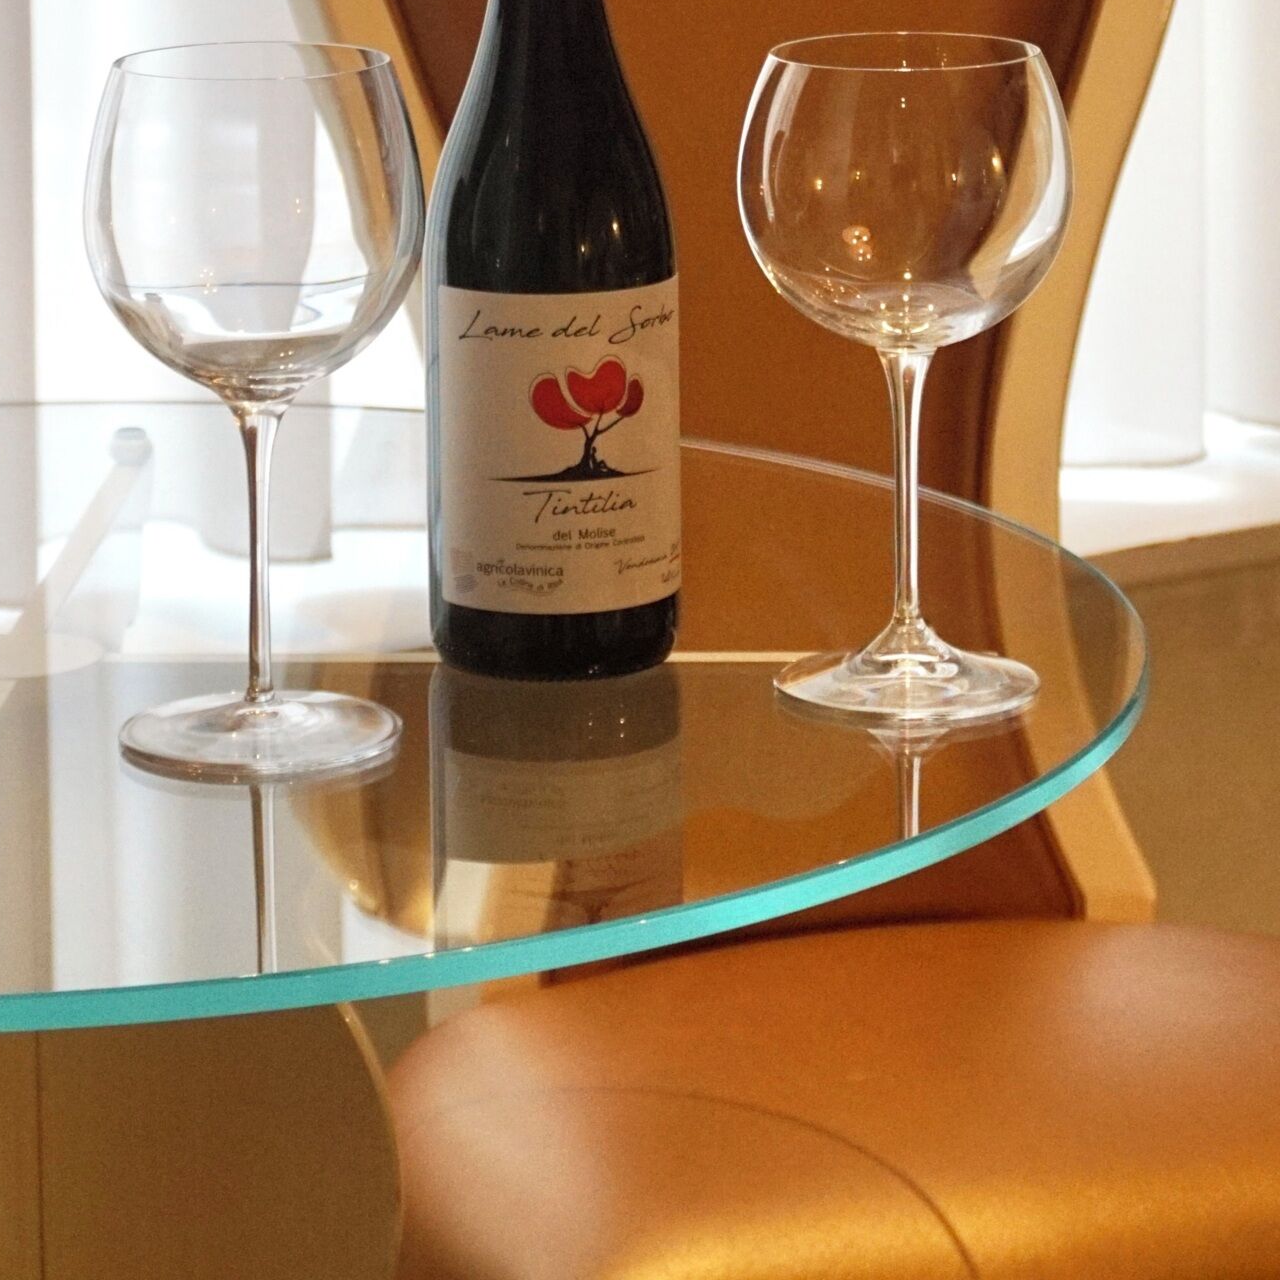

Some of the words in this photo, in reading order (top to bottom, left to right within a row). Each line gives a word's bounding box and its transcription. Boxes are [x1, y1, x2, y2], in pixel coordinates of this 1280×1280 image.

[459, 309, 544, 341] Lame
[551, 314, 601, 338] del
[522, 489, 637, 524] Tintilia
[552, 528, 571, 542] del
[578, 526, 616, 541] Molise
[476, 561, 564, 577] agricolavinica
